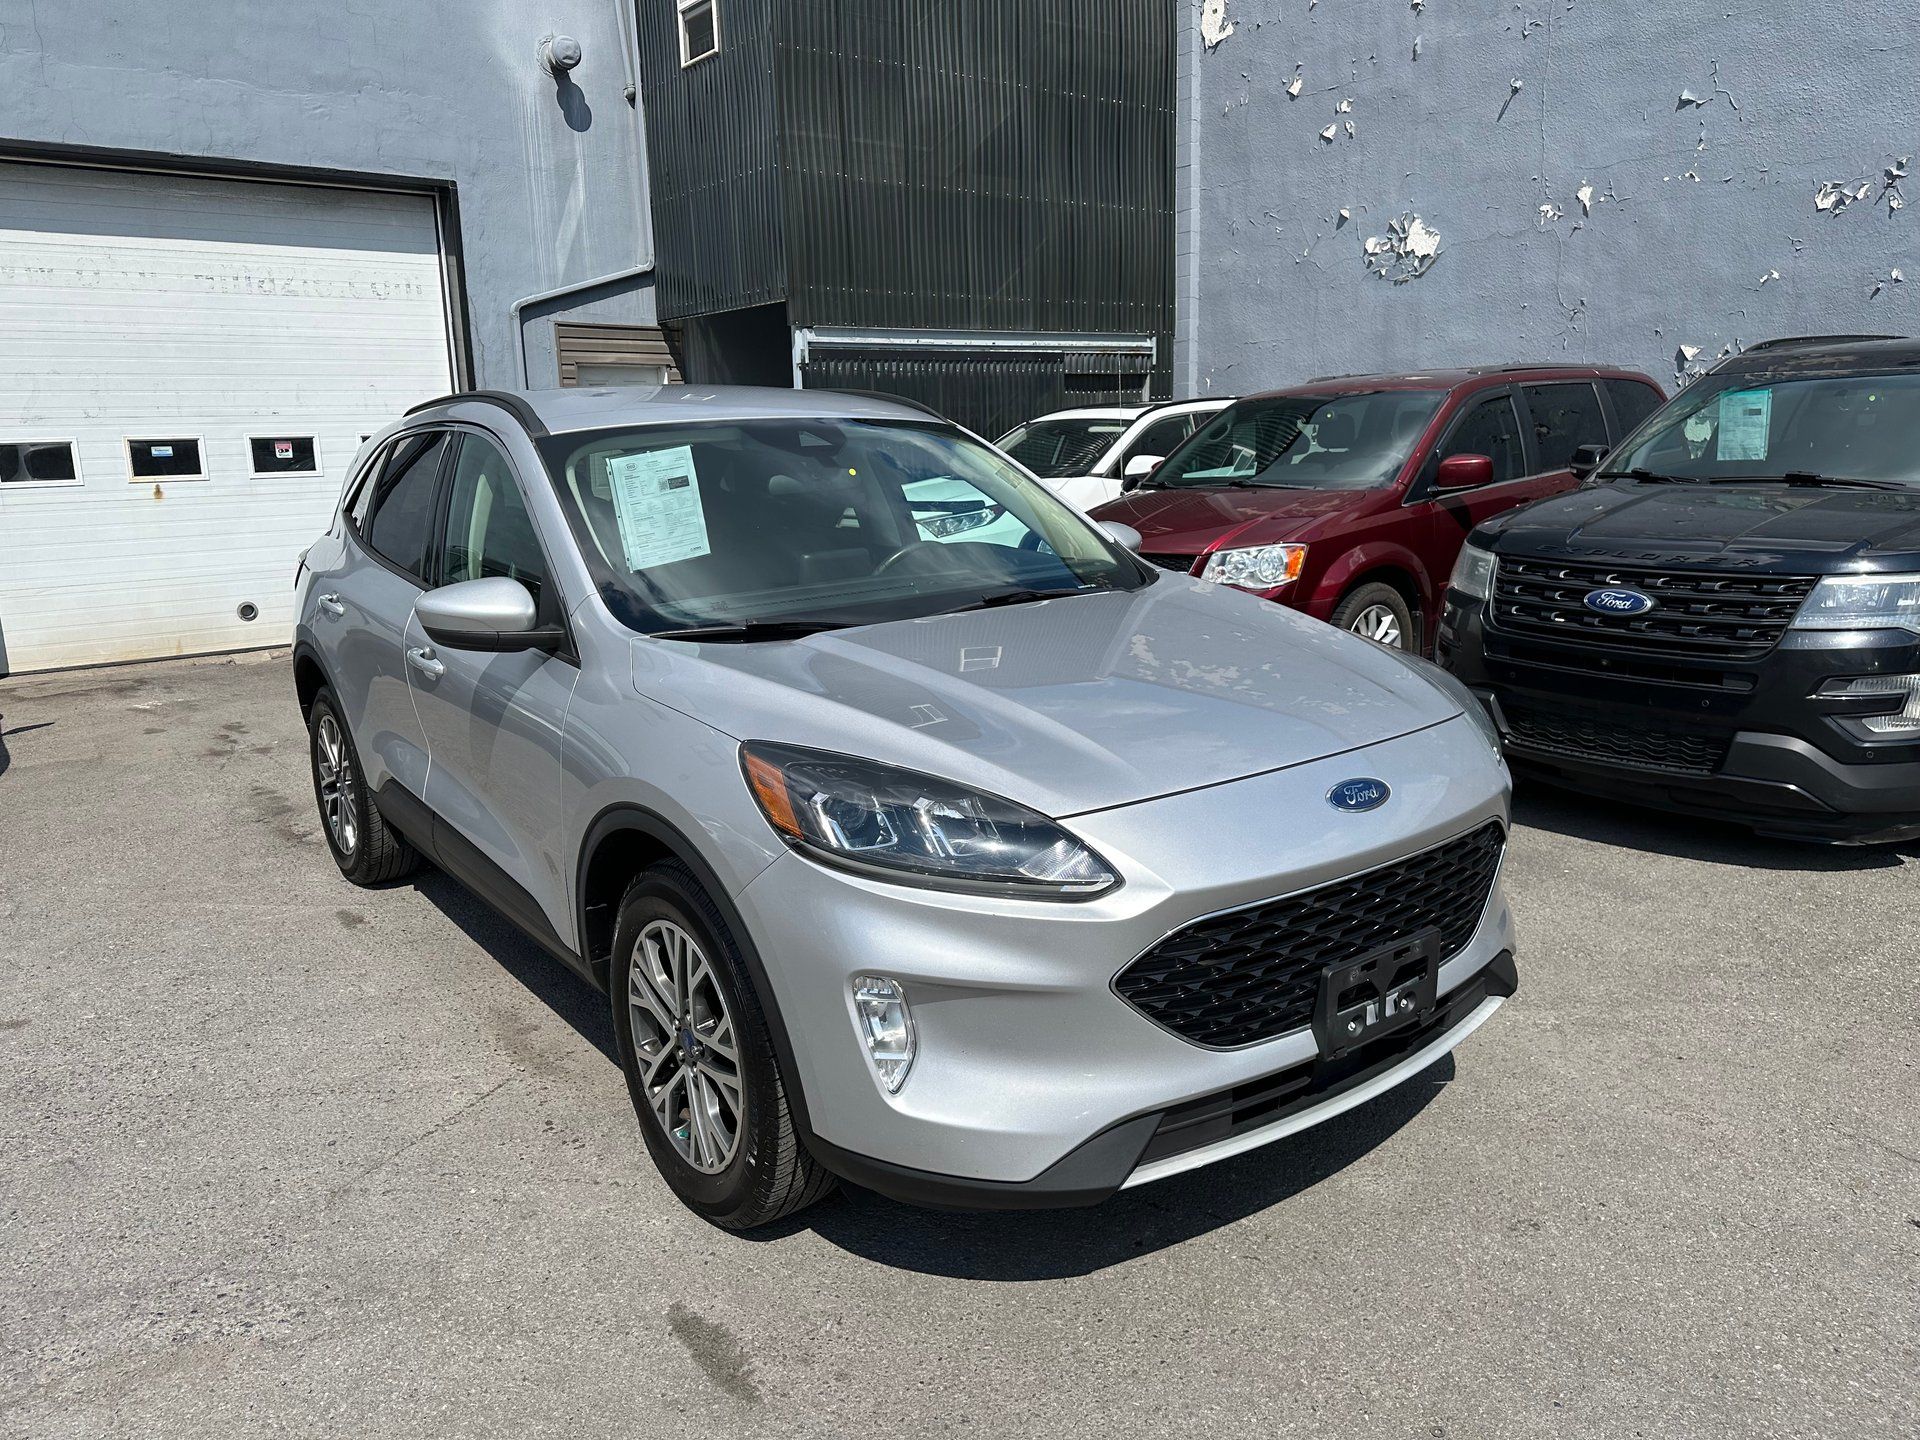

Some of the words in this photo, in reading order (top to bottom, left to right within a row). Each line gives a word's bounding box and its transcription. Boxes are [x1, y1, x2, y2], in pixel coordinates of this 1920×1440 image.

[1535, 543, 1760, 568] EXPLORER
[1595, 591, 1635, 610] Ford
[1342, 782, 1380, 805] Ford
